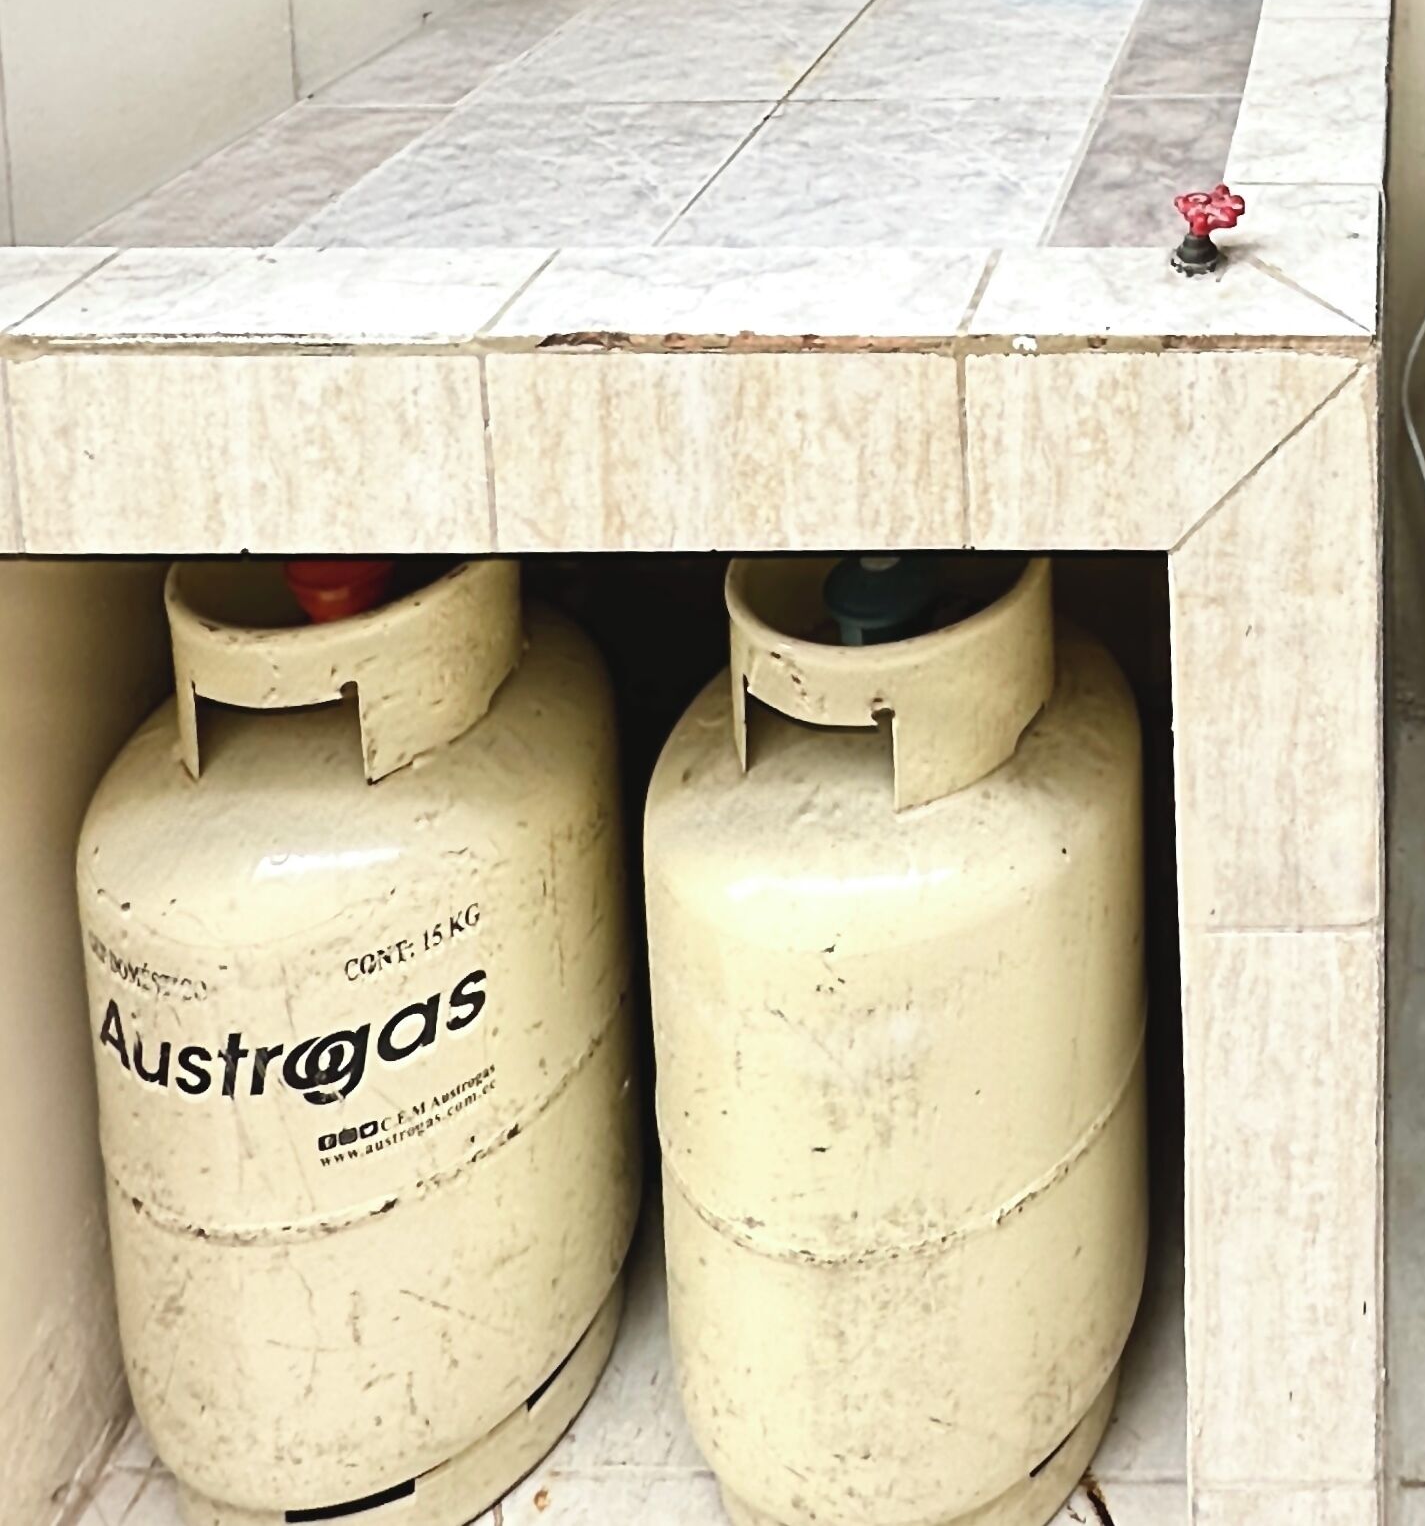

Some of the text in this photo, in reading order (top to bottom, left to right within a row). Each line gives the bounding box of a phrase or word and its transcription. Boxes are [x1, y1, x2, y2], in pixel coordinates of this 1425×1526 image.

[423, 922, 443, 951] 15
[450, 902, 480, 938] KG
[100, 969, 487, 1106] Austrogas
[431, 1064, 496, 1108] Austrogas
